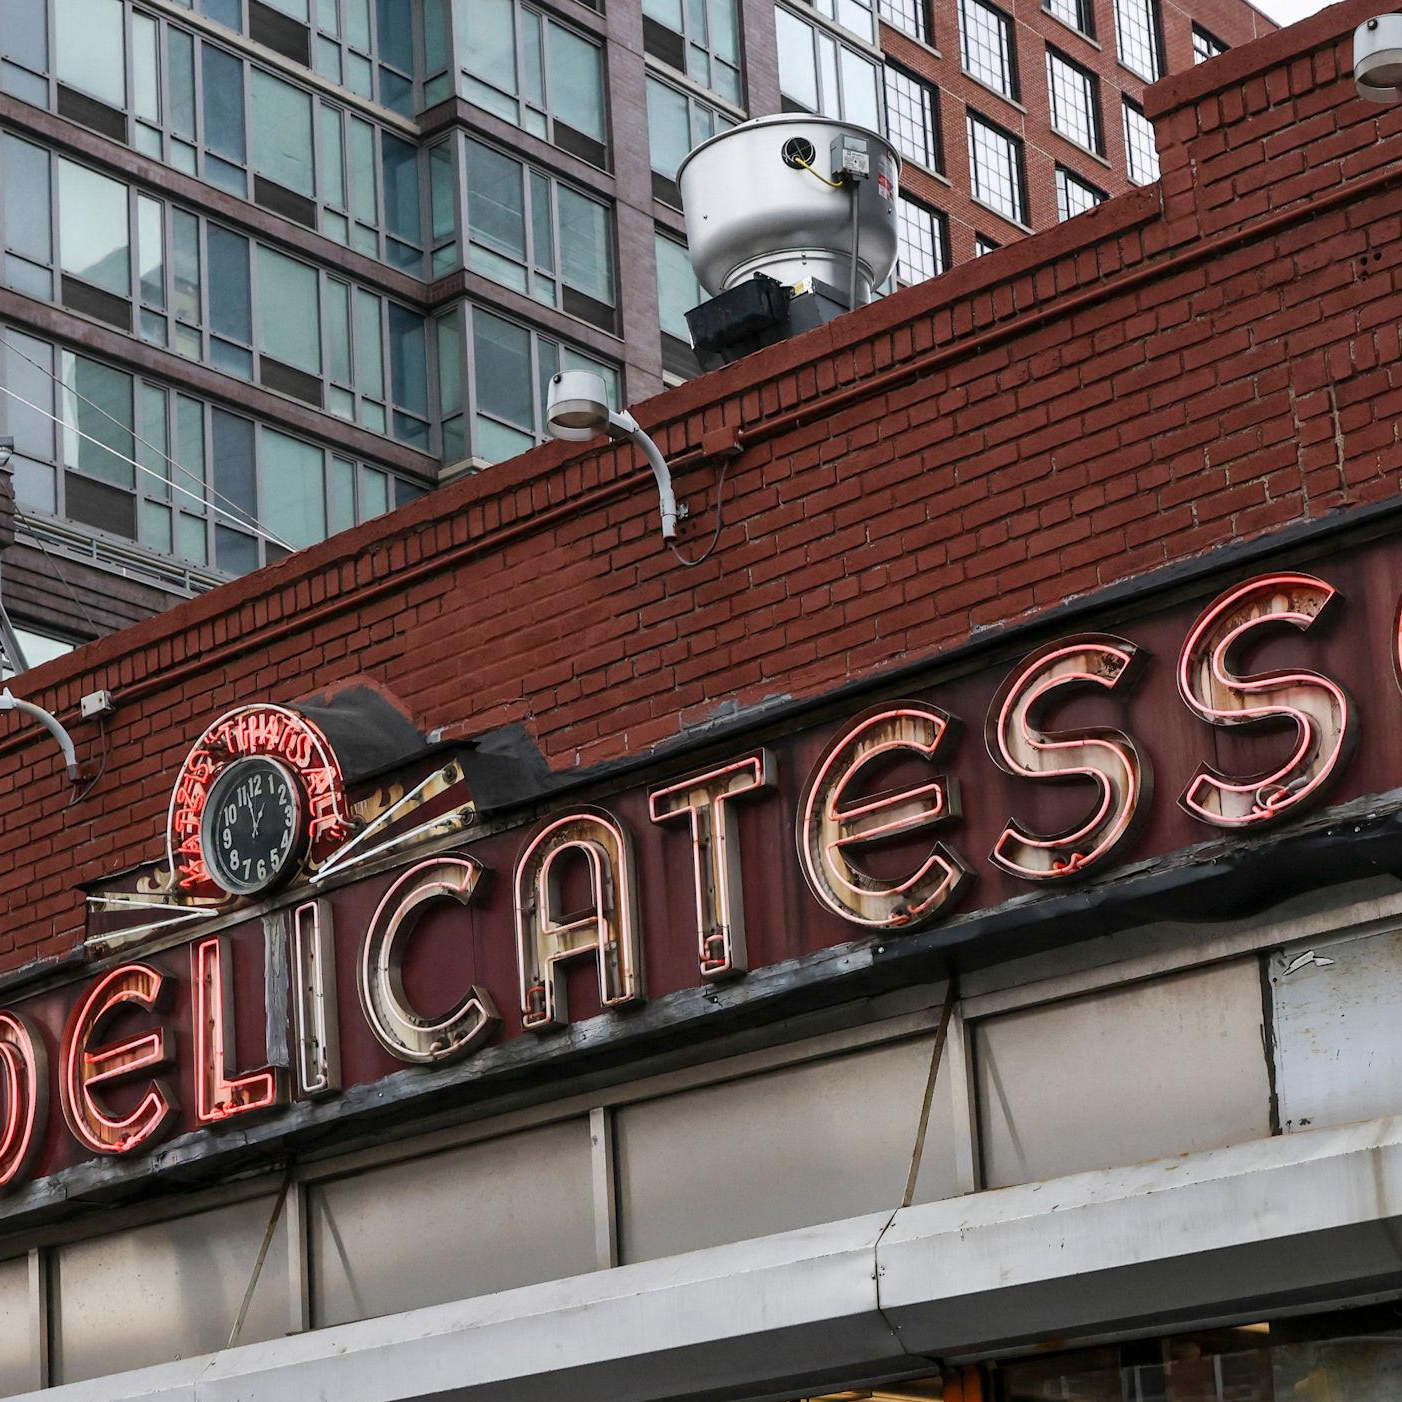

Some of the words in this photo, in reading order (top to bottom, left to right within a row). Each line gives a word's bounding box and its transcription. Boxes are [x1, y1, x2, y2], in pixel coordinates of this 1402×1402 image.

[236, 784, 248, 807] 11
[248, 774, 263, 798] 12
[267, 774, 275, 795] 1
[278, 783, 287, 806] 2
[223, 803, 237, 827] 10
[284, 805, 293, 827] 3
[222, 828, 232, 850] 9
[280, 829, 289, 850] 4
[229, 849, 240, 871] 8
[242, 858, 252, 881] 7
[256, 859, 267, 881] 6
[270, 848, 280, 870] 5
